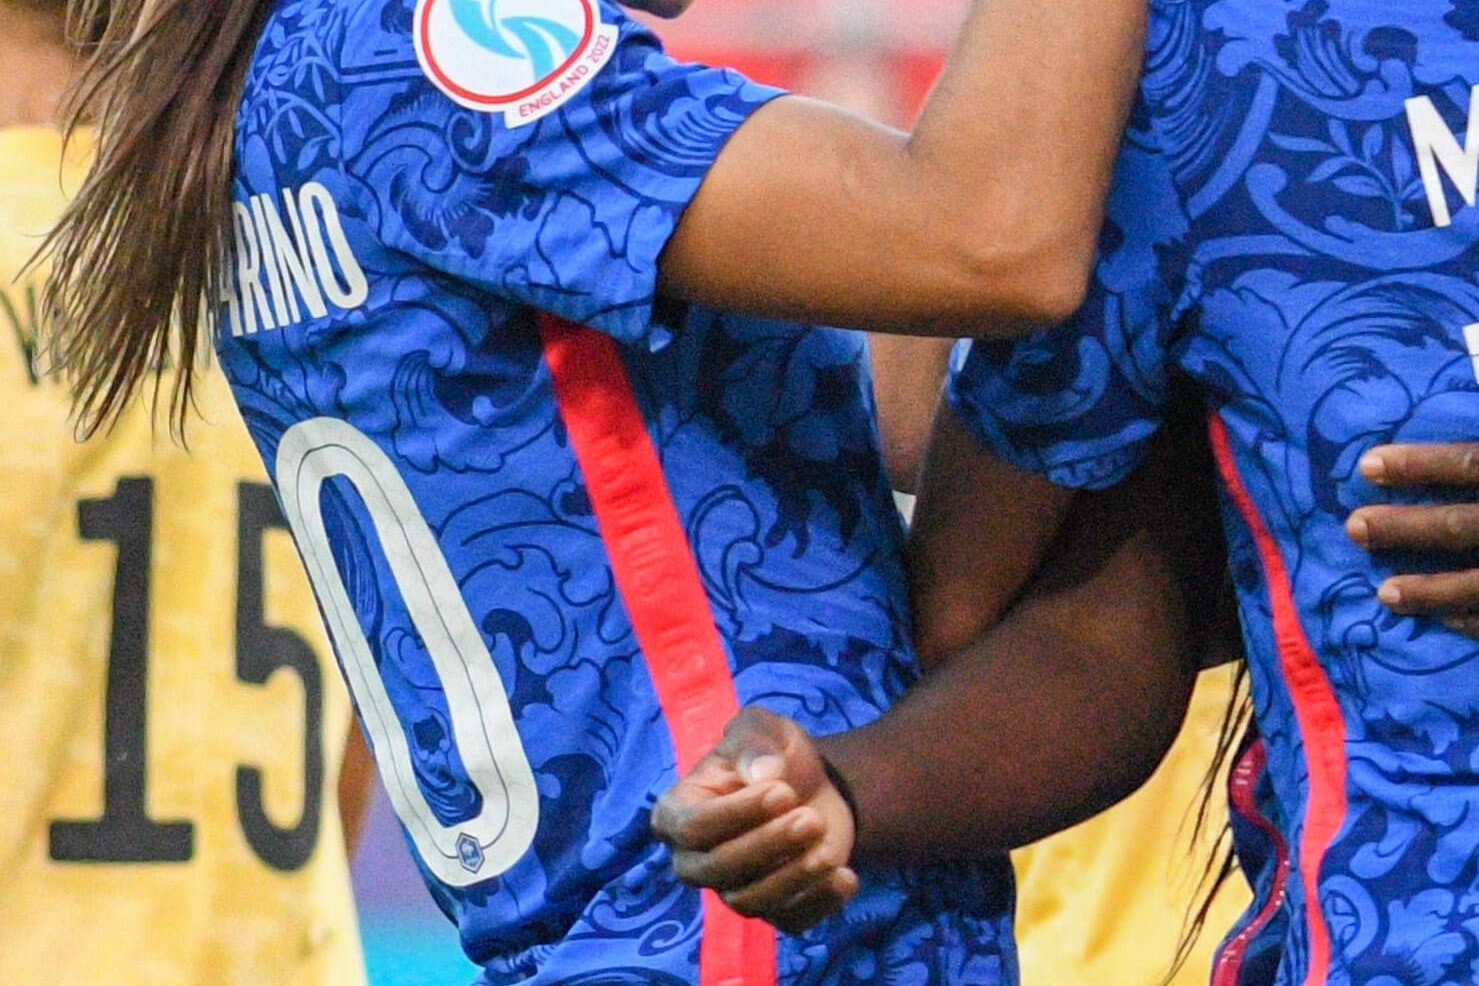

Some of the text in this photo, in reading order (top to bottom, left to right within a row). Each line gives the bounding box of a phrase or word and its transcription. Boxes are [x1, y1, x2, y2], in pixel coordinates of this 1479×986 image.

[519, 34, 611, 117] ENGLAND 2022
[48, 477, 324, 872] 15
[275, 418, 539, 886] 0
